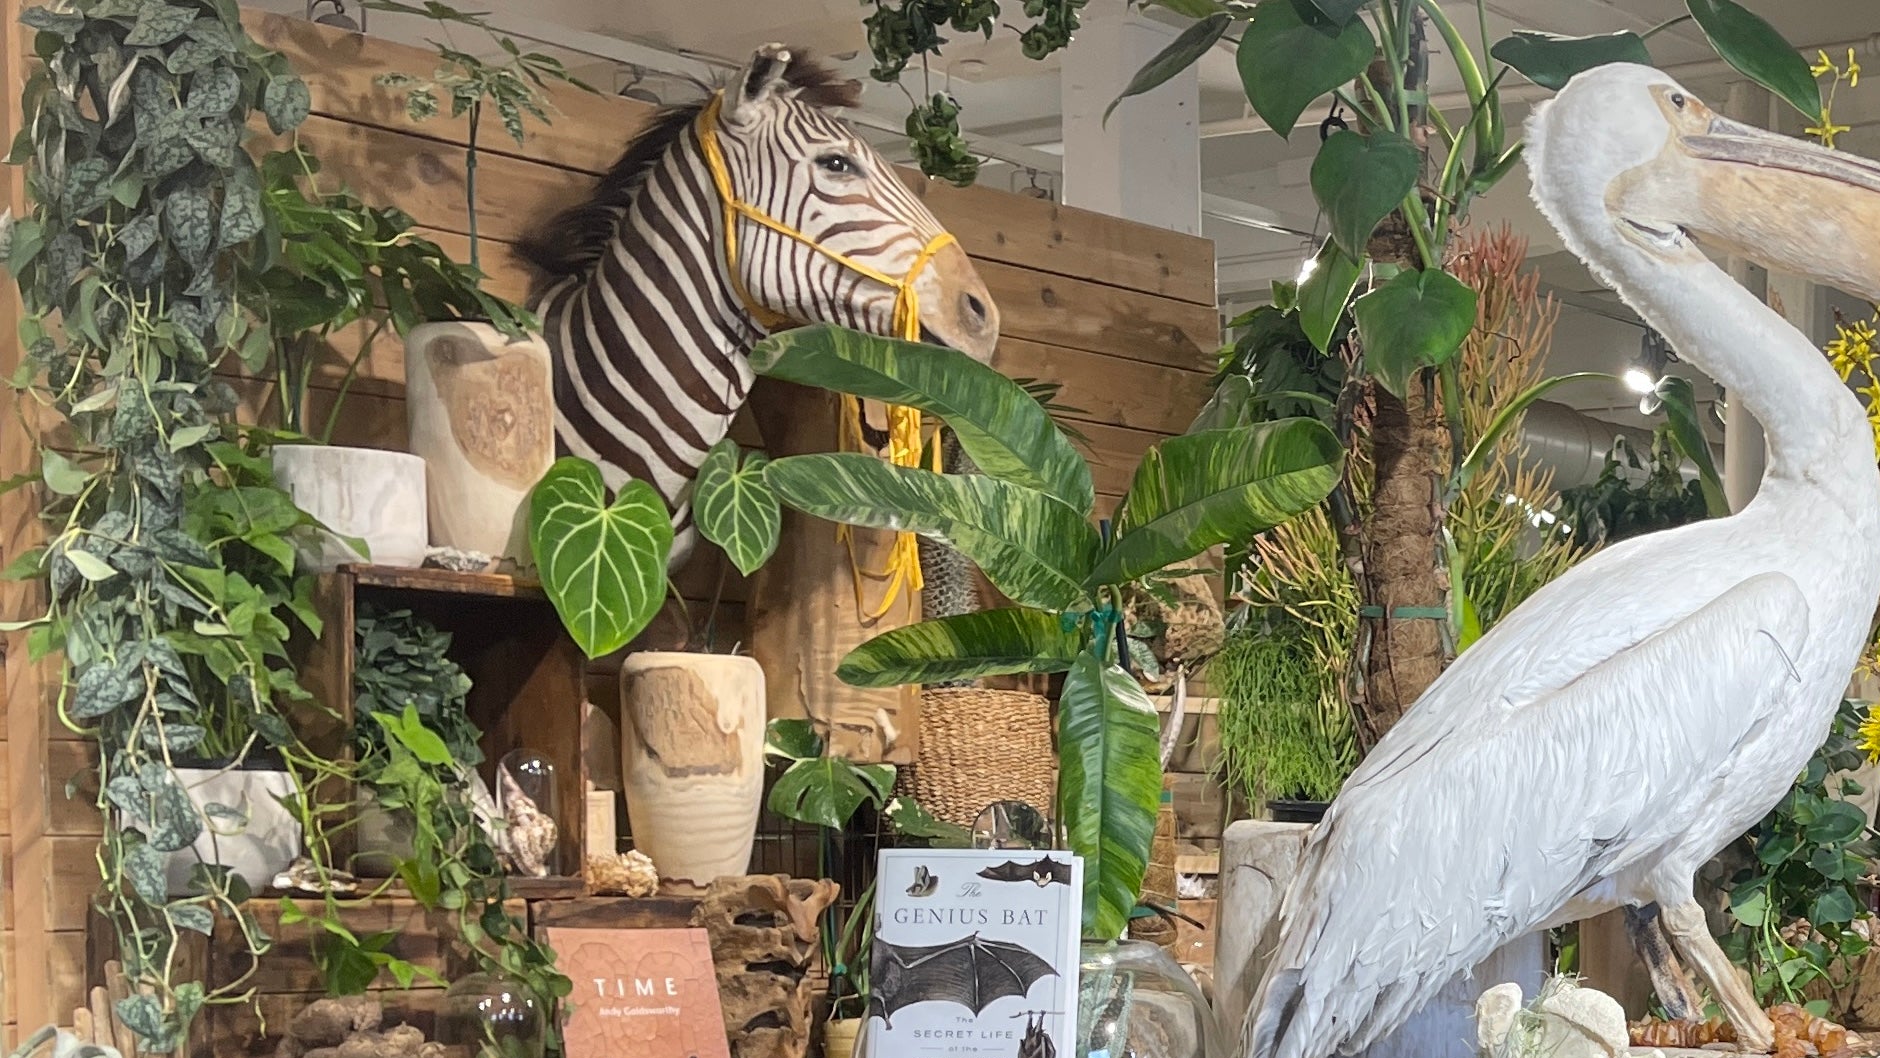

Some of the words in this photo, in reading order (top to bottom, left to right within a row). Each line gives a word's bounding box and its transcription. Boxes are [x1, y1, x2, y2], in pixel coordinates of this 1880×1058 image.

[956, 882, 982, 897] The
[894, 908, 988, 925] GENIUS
[1002, 909, 1048, 925] BAT
[593, 977, 678, 997] TIME
[914, 1030, 972, 1039] SECRET
[981, 1031, 1014, 1039] LIFE
